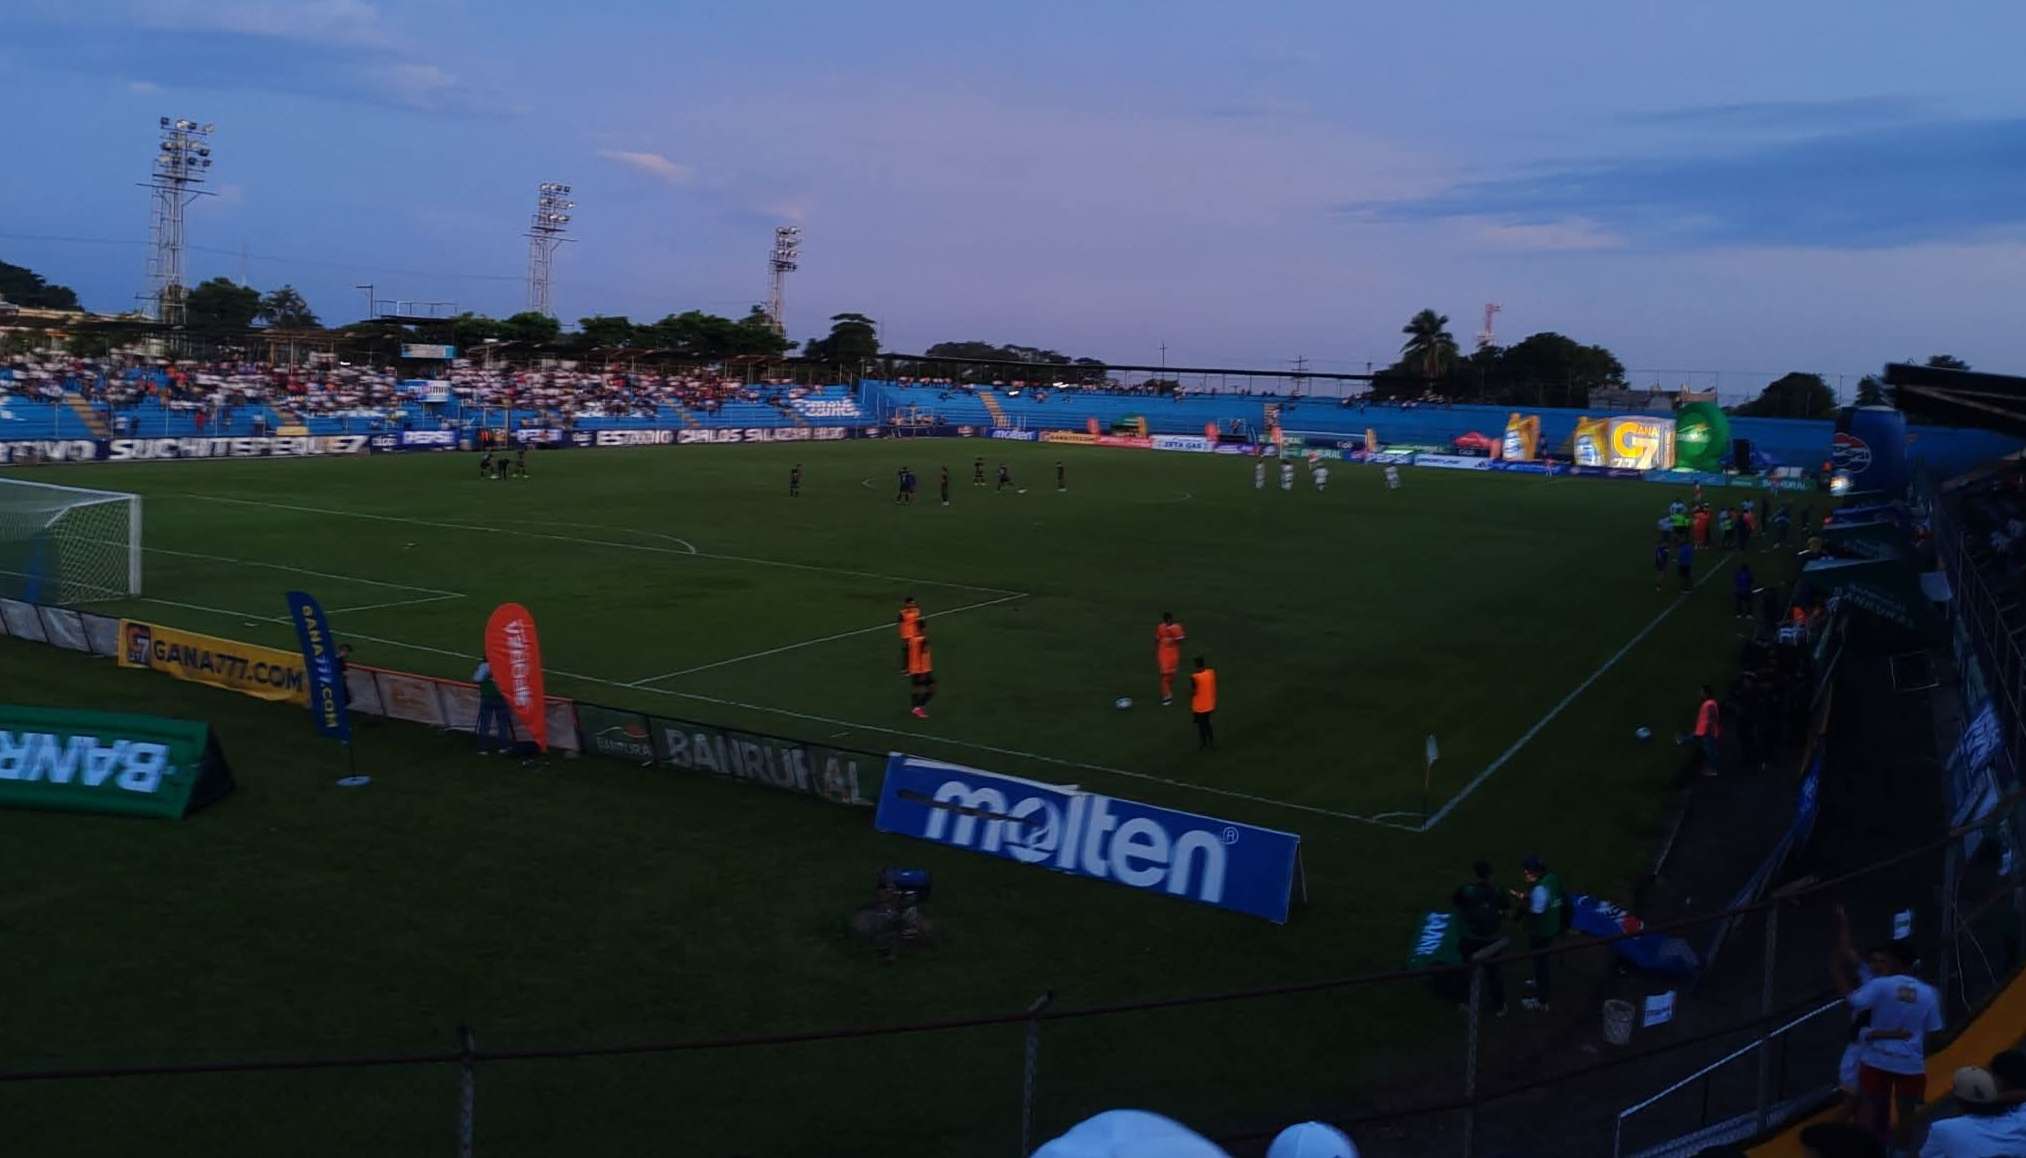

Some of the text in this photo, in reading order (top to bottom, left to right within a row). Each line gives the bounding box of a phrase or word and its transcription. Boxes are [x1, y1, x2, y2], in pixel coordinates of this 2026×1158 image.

[153, 638, 304, 693] GANA777.COM
[301, 604, 340, 729] GANA777.COM
[924, 780, 1229, 904] molten
